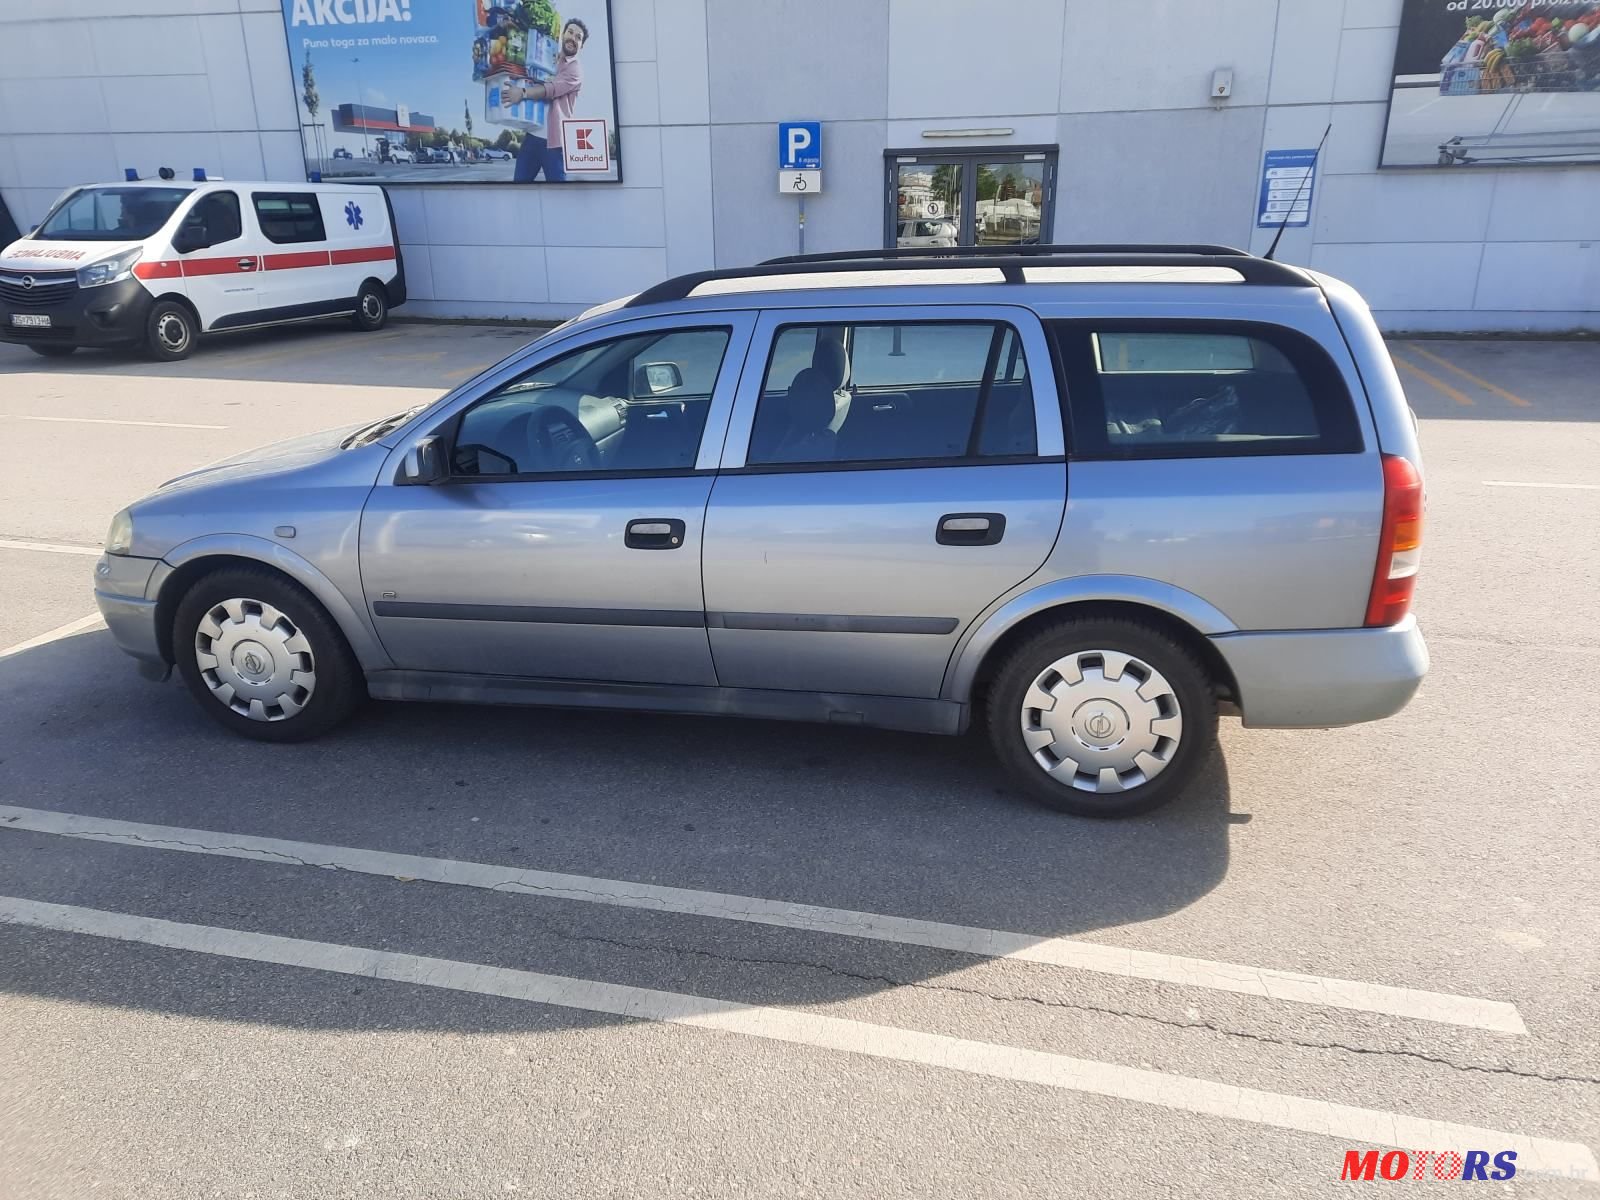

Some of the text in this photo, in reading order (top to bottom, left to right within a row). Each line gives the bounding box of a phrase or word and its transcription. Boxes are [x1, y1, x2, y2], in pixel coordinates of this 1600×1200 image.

[1447, 0, 1467, 11] od
[1471, 0, 1529, 10] 20.000
[291, 0, 412, 27] AKCIJA!
[303, 35, 439, 48] Puno toga za malo novaca.
[788, 127, 811, 163] P
[569, 154, 604, 162] Kaufland
